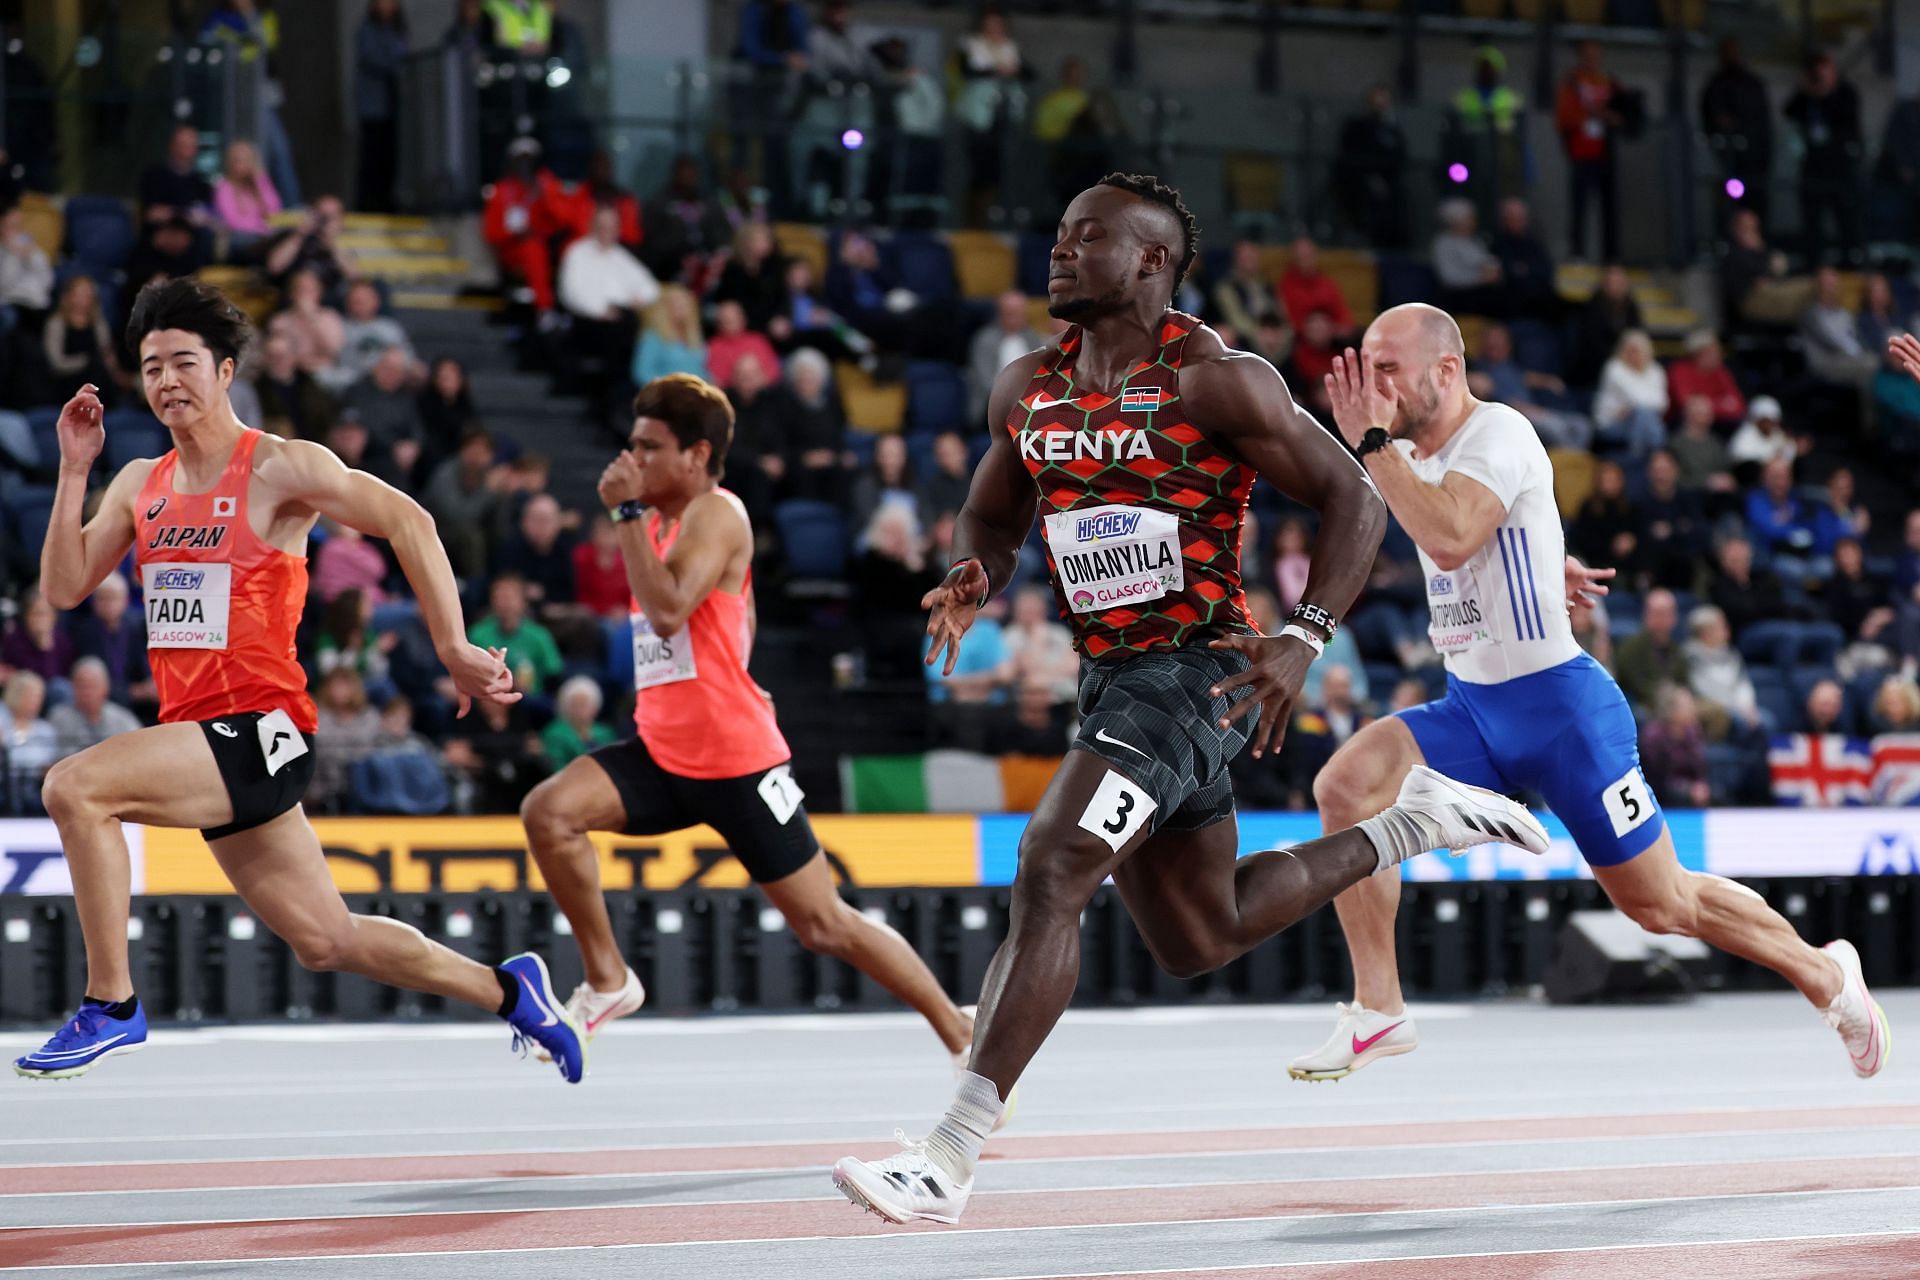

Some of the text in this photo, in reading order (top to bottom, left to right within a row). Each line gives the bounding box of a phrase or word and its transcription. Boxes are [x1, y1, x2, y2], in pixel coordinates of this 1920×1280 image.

[1020, 429, 1156, 461] KENYA
[148, 525, 227, 550] JAPAN
[1076, 511, 1141, 541] HI-CHEW
[149, 598, 205, 624] TADA
[149, 631, 223, 643] GLASGOW 24
[1102, 790, 1135, 835] 3
[1619, 785, 1640, 822] 5
